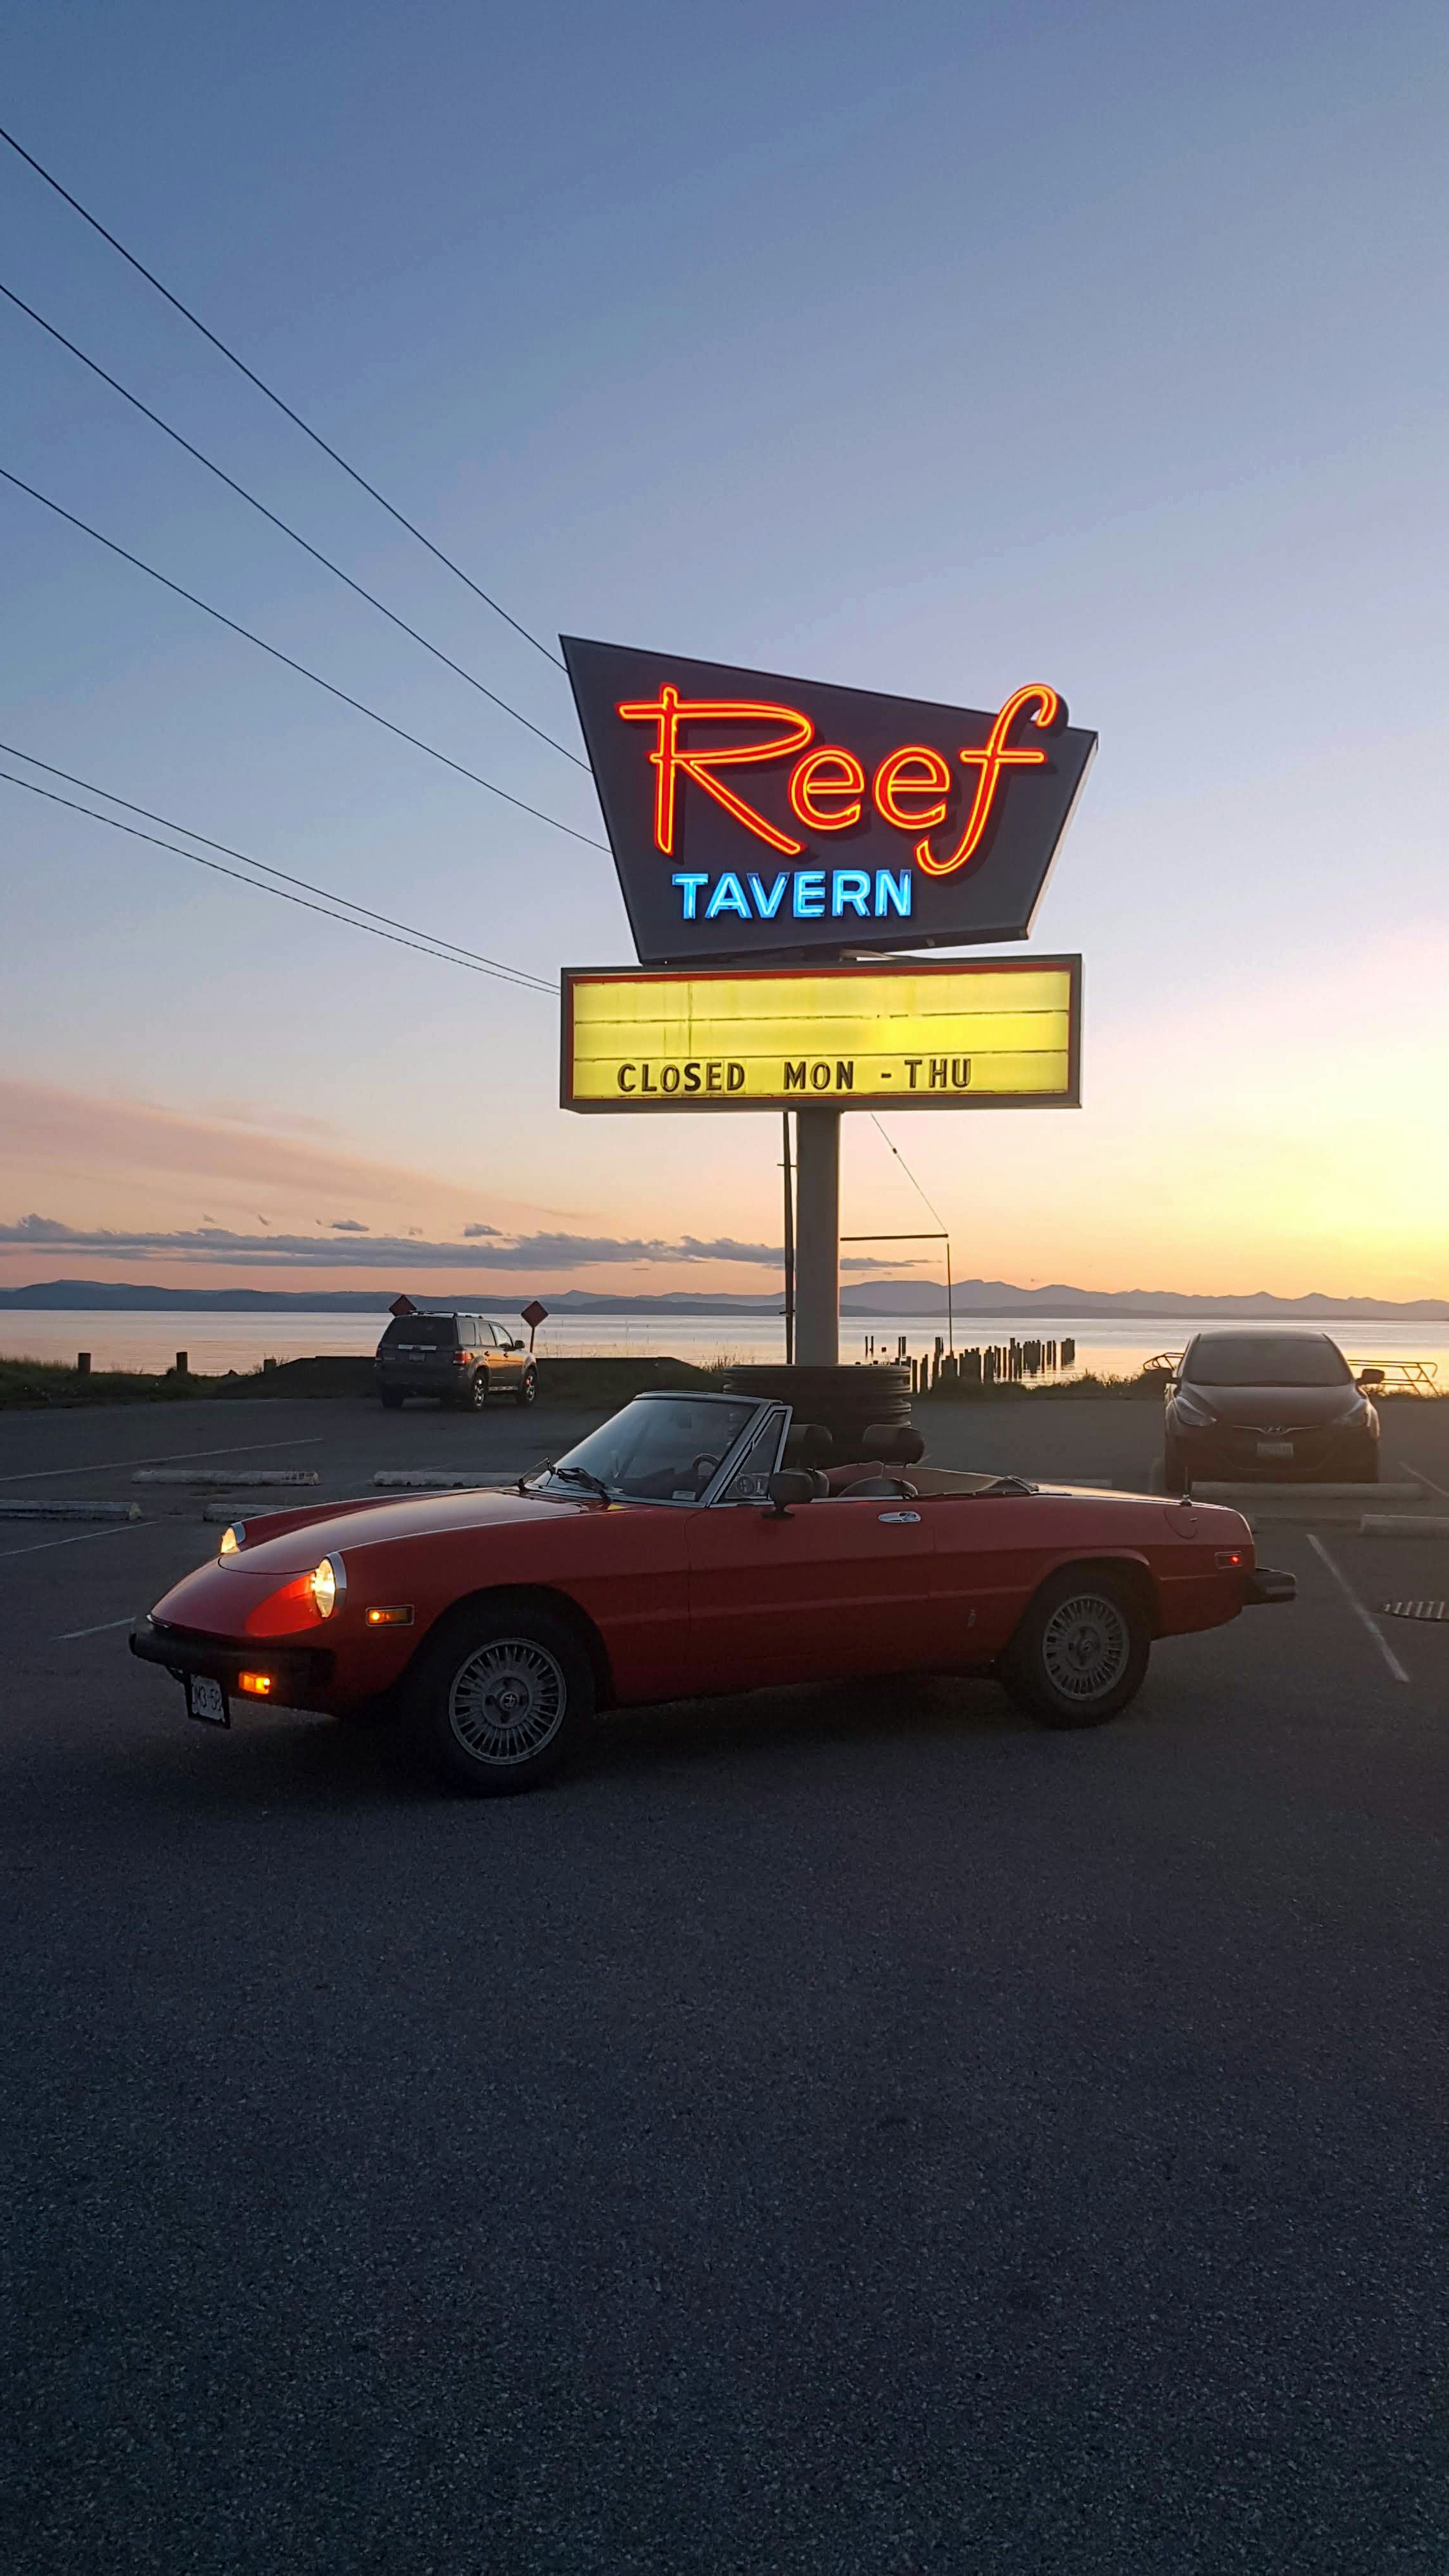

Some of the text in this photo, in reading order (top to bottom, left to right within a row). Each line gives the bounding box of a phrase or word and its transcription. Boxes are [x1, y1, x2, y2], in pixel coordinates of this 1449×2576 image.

[617, 684, 1058, 875] Reef
[671, 869, 912, 920] TAVERN
[617, 1062, 746, 1092] CLOSED
[783, 1061, 854, 1090] MON
[904, 1059, 970, 1089] THU
